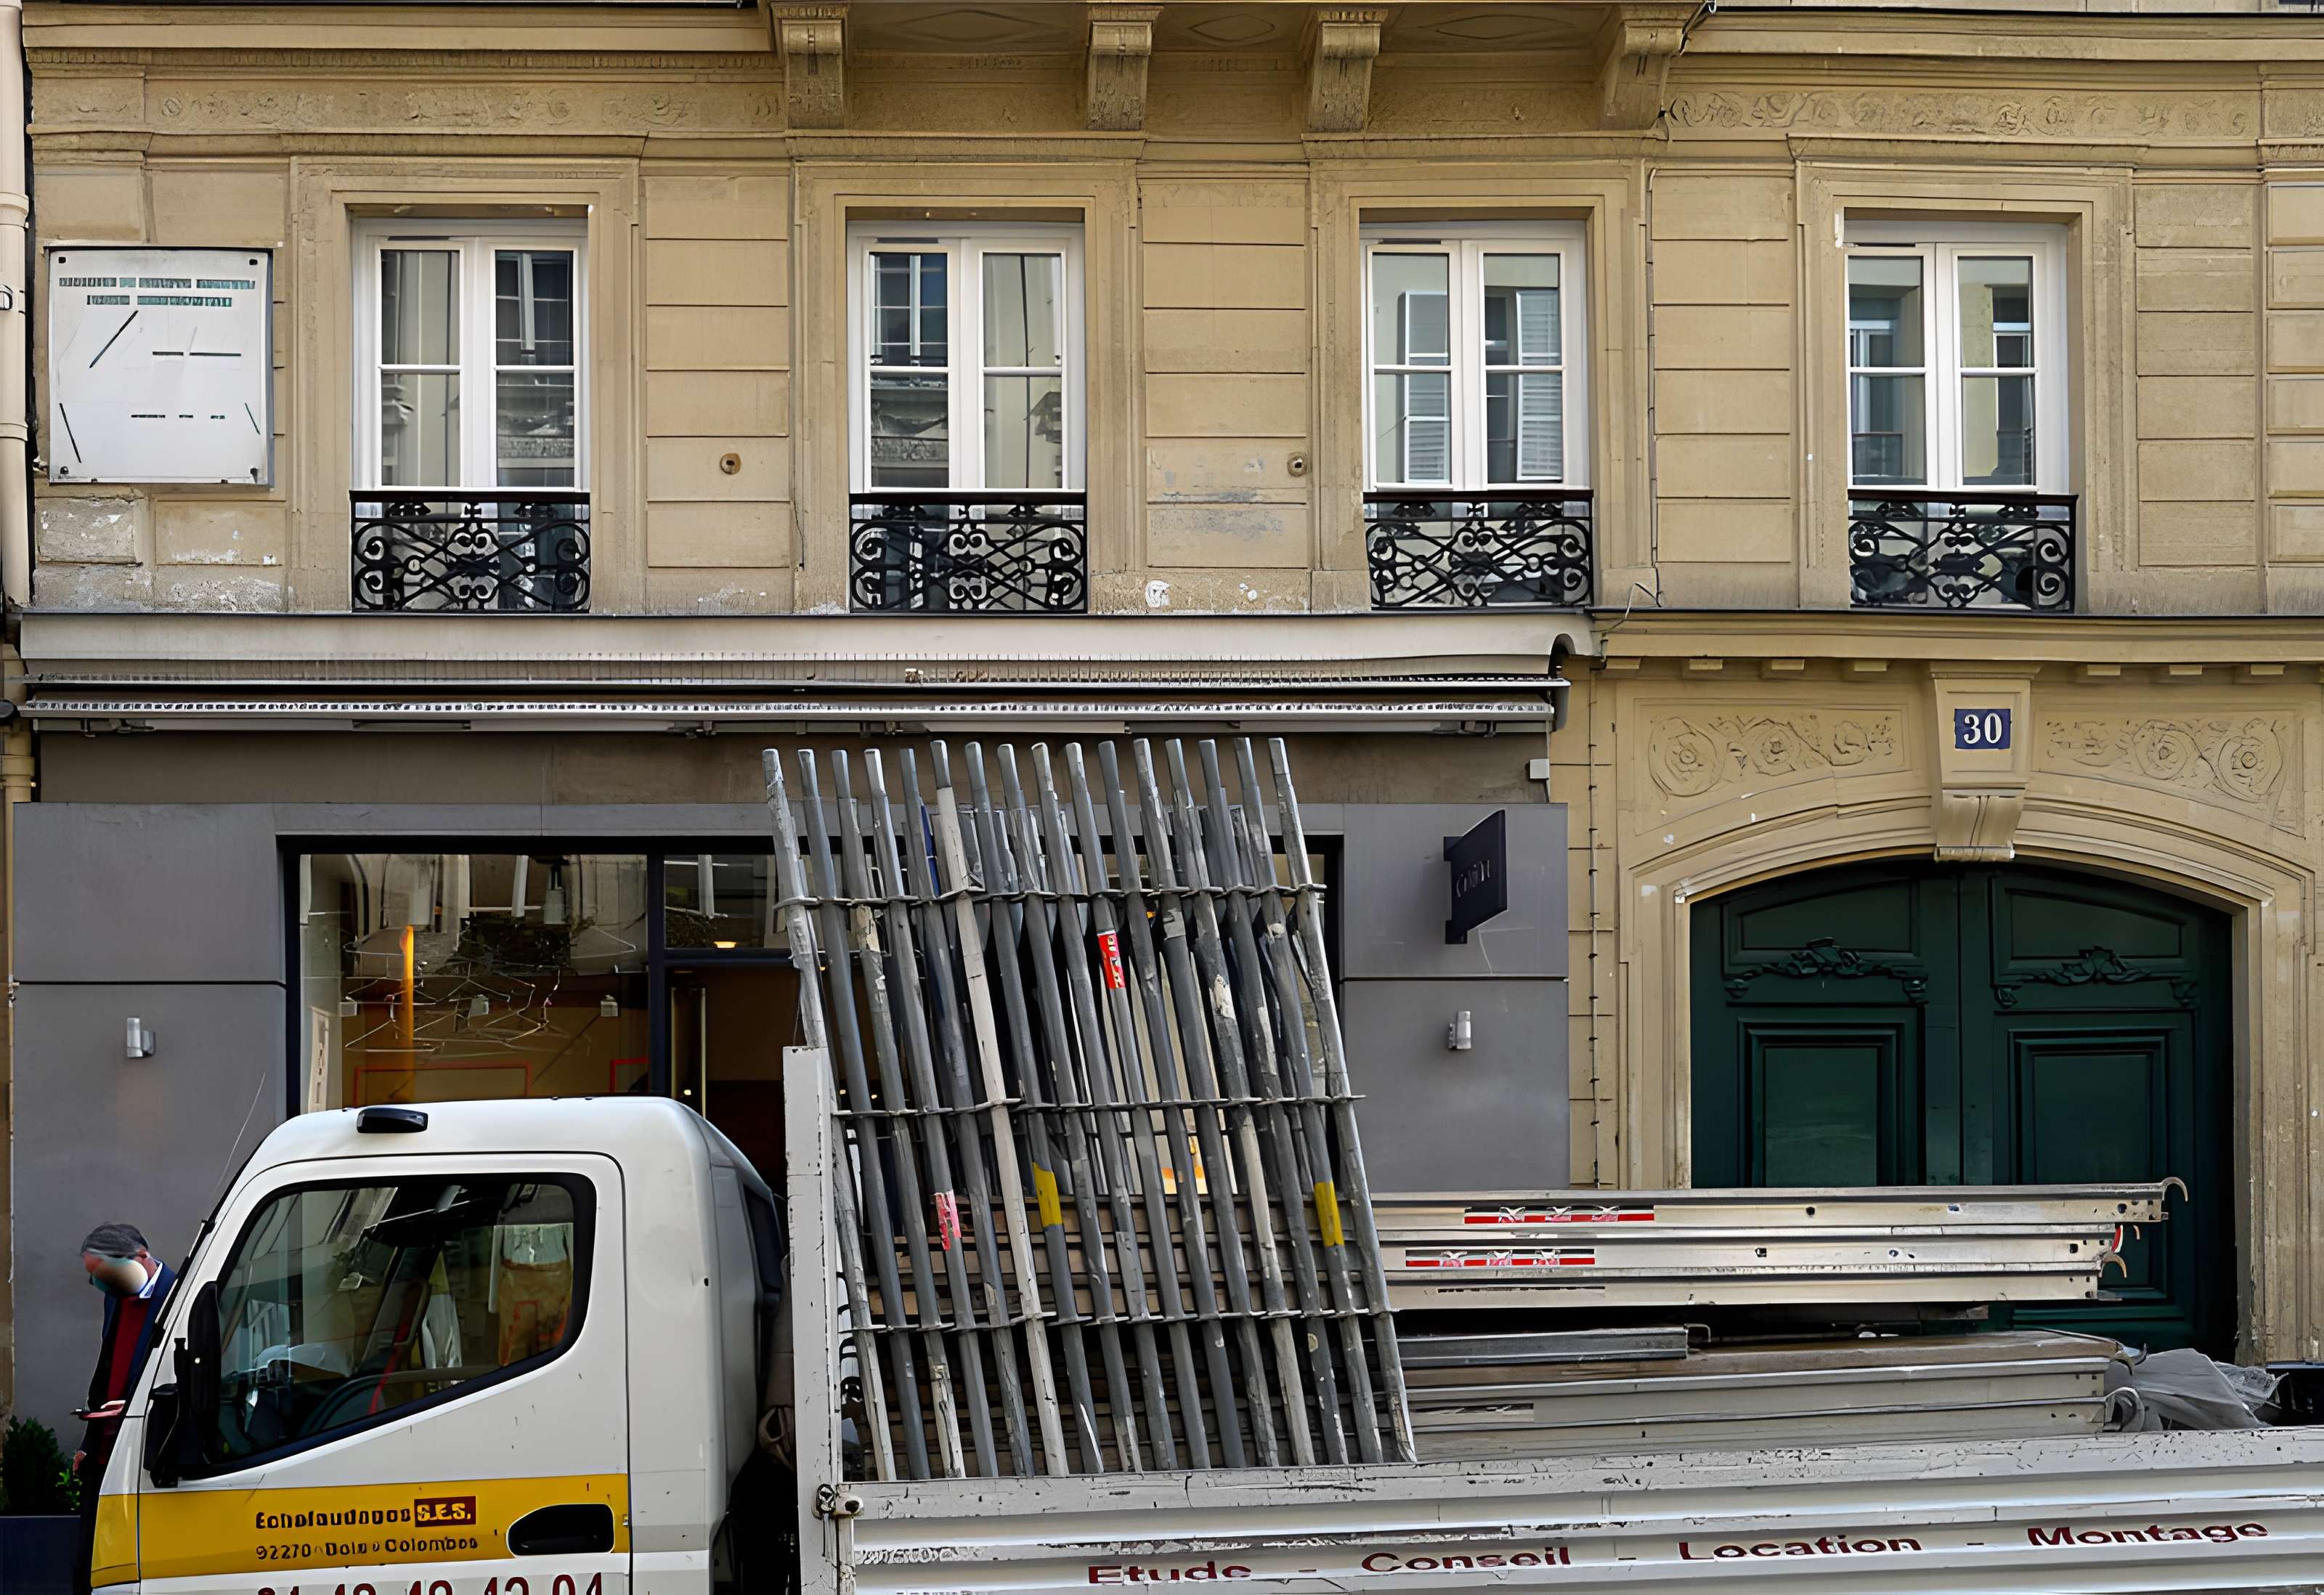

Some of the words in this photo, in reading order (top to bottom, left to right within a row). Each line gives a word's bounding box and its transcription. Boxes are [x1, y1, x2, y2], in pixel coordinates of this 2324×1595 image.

[1964, 713, 2002, 744] 30
[256, 1543, 312, 1560] 92270
[1361, 1546, 1572, 1572] Conseil
[1678, 1535, 1923, 1560] Location
[2027, 1522, 2270, 1546] Montage
